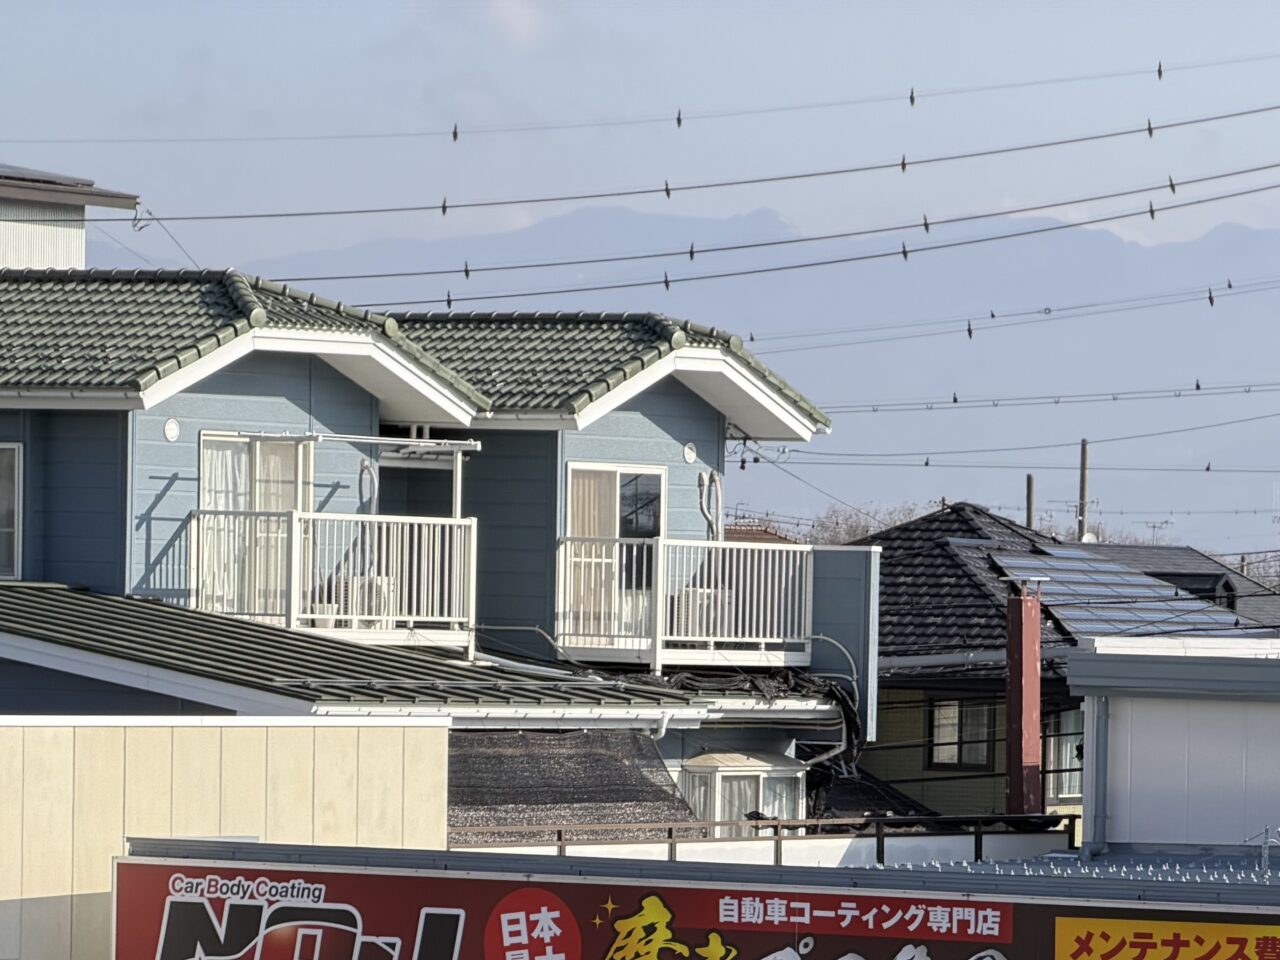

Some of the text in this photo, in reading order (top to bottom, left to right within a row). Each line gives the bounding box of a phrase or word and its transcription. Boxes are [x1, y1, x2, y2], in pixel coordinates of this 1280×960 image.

[171, 875, 323, 902] Car Body Coating
[500, 906, 563, 947] 日本
[718, 895, 1000, 937] 自動車コーティング専門店
